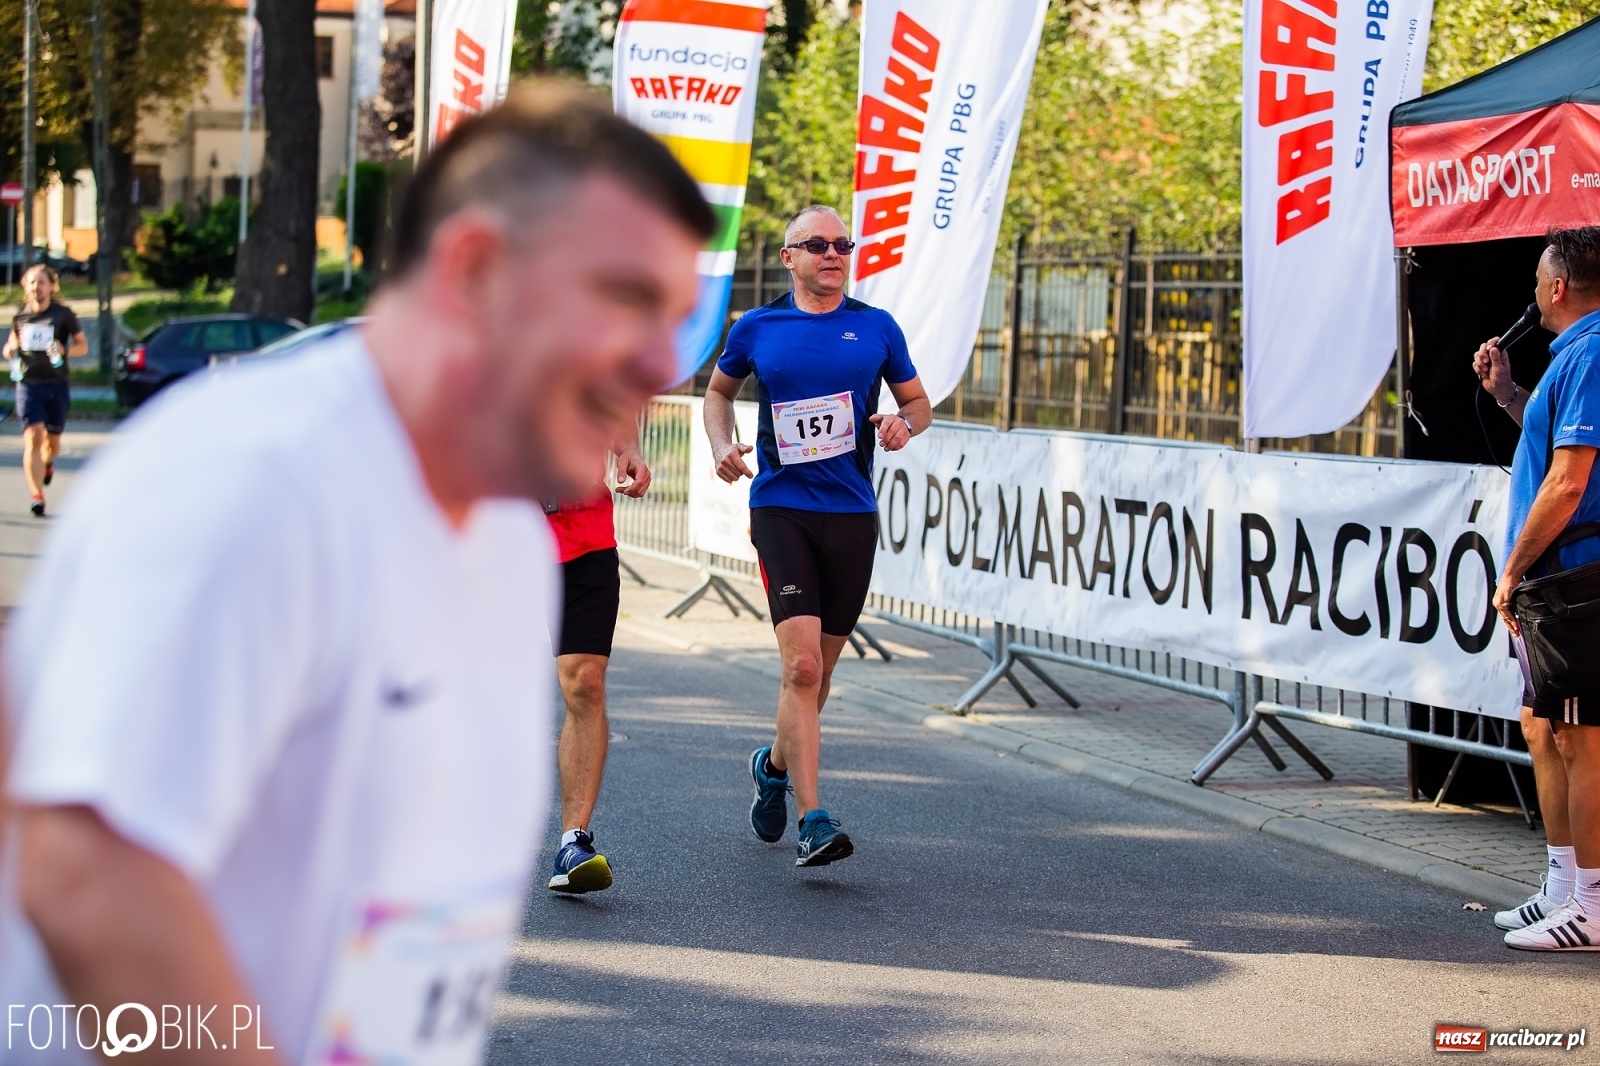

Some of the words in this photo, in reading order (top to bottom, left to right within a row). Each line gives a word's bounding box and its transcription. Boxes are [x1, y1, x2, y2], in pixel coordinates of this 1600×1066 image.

[629, 43, 747, 73] fundacja
[630, 75, 743, 106] RAFAKO
[854, 10, 941, 282] RAFAKO
[933, 147, 964, 230] GRUPA
[949, 83, 976, 134] PBG
[1354, 57, 1382, 169] GRUPA
[1407, 145, 1556, 208] DATASPORT
[796, 414, 834, 439] 157
[921, 453, 1214, 615] PÓŁMARATON
[1240, 500, 1519, 658] RACIBÓ
